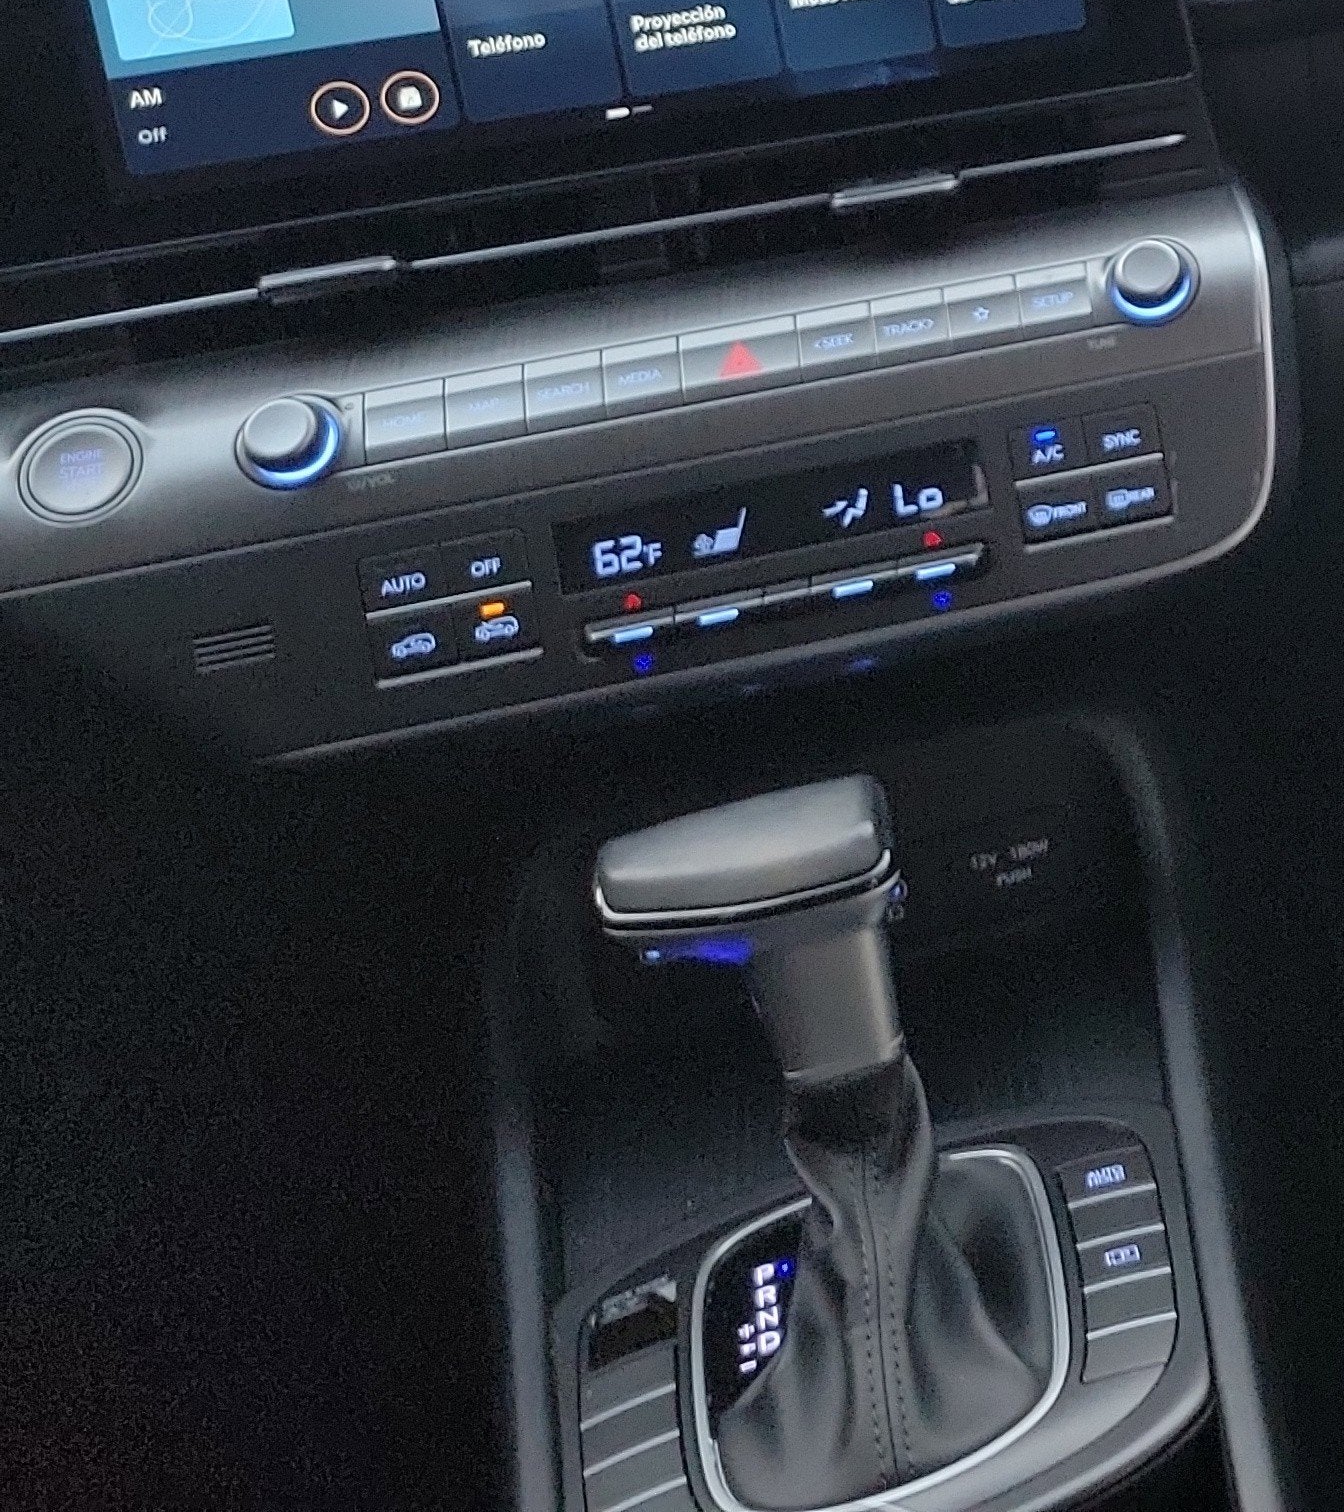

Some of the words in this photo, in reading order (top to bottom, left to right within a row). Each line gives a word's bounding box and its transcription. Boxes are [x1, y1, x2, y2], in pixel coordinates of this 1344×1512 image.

[630, 3, 726, 34] Proyección
[468, 30, 546, 59] Teléfono
[634, 32, 662, 52] del
[130, 88, 163, 108] AM
[138, 126, 168, 145] Off
[1101, 428, 1142, 451] SYNC
[1031, 444, 1065, 466] A/C
[470, 556, 501, 579] OFF
[381, 571, 427, 597] AUTO
